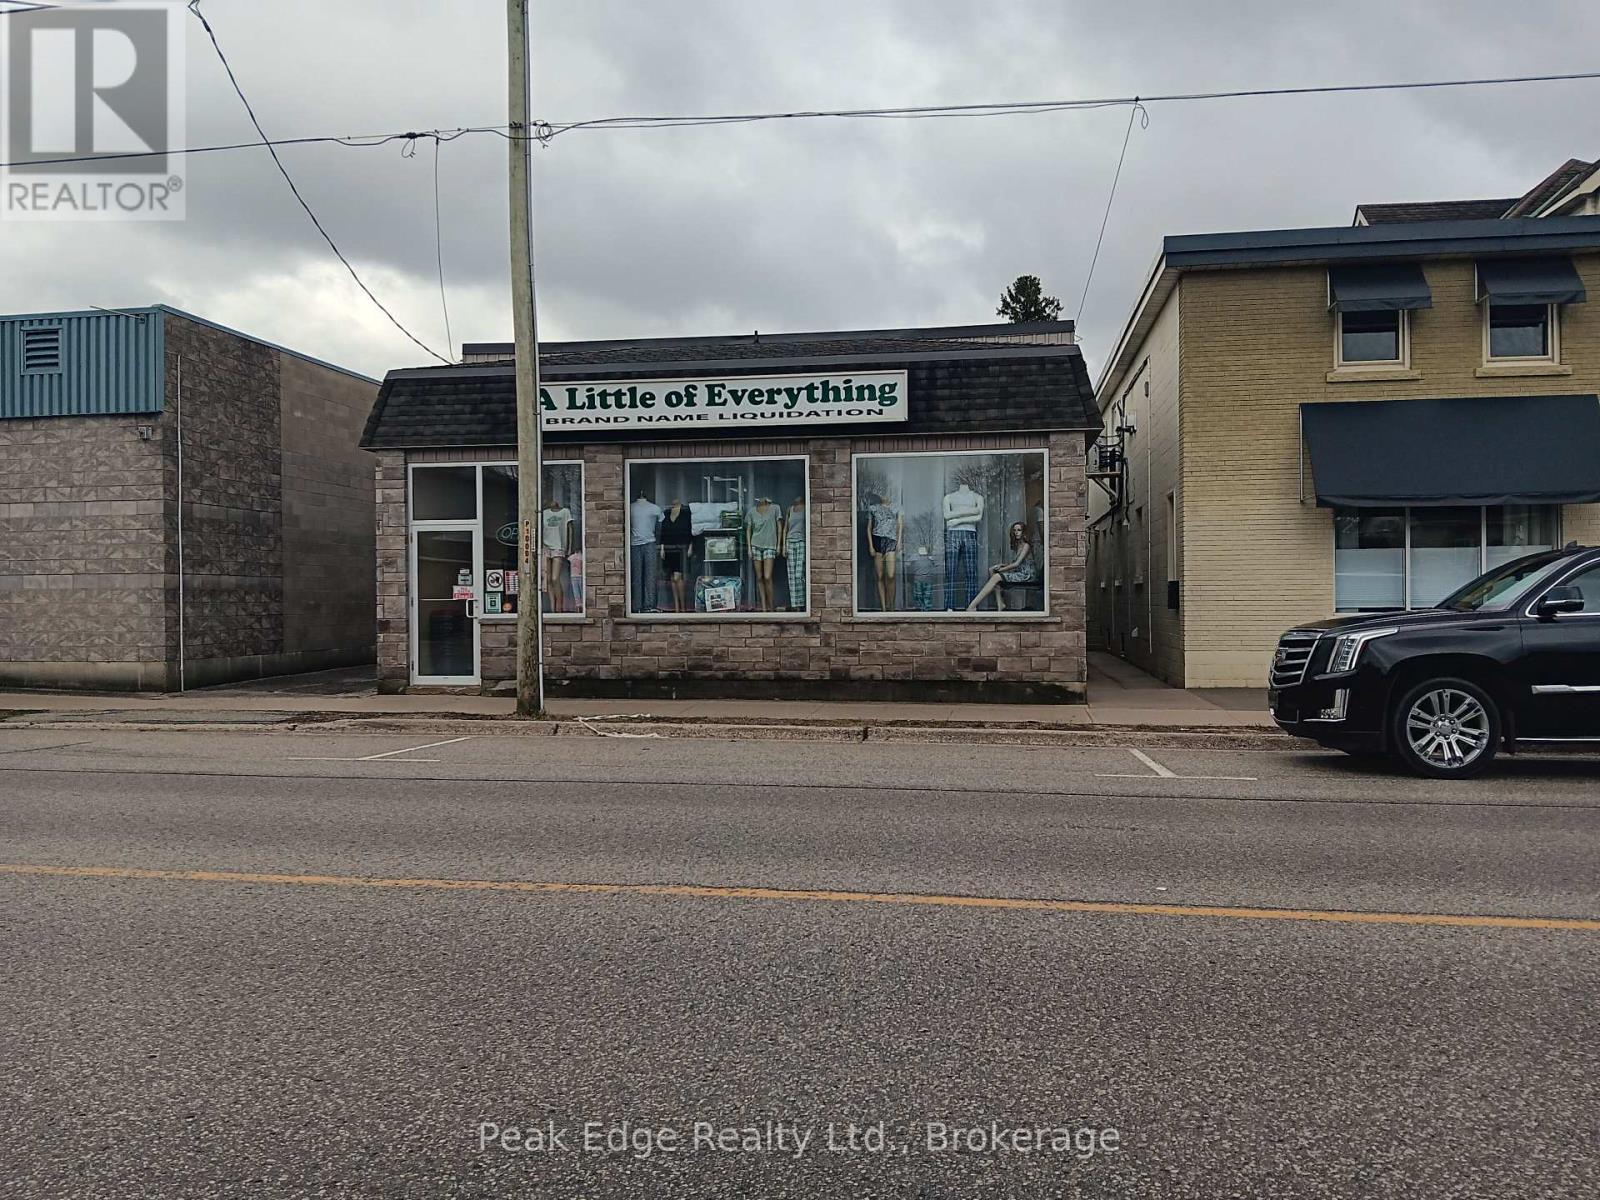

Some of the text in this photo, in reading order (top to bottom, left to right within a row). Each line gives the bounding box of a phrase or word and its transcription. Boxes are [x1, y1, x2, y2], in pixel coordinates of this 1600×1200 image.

[540, 378, 898, 411] A Little of Everything
[545, 408, 884, 425] BRAND NAME LIQUIDATION
